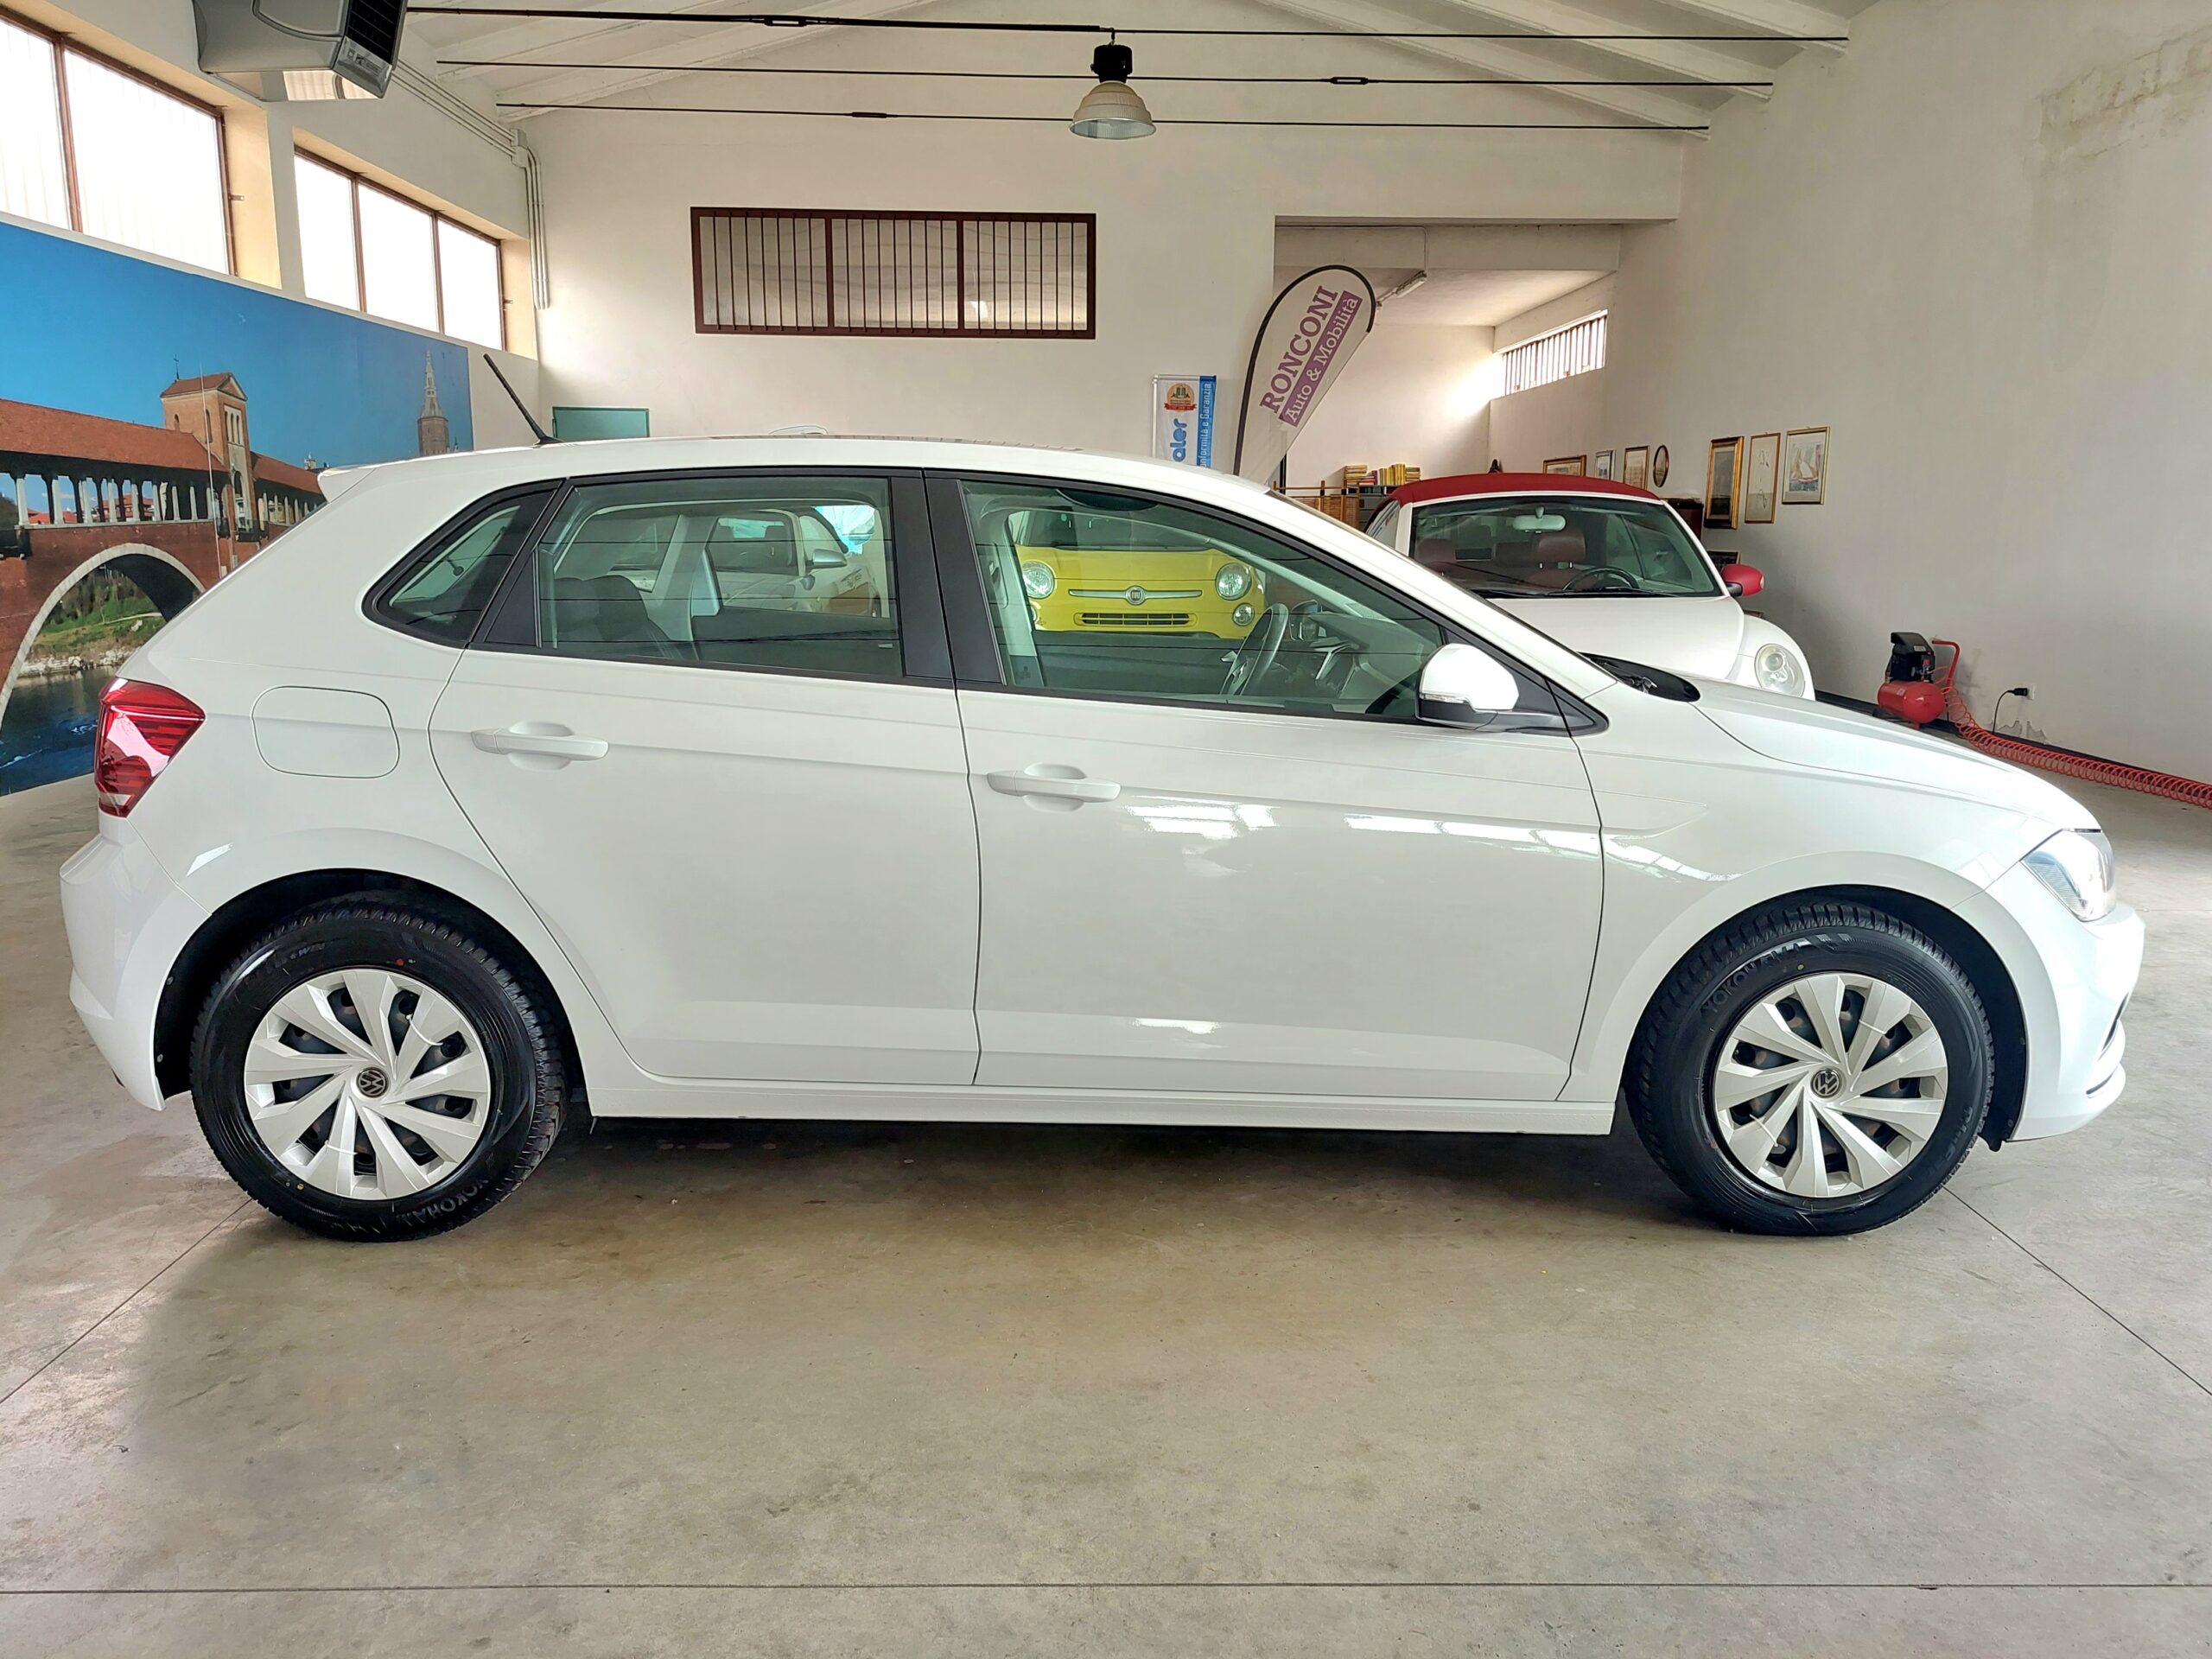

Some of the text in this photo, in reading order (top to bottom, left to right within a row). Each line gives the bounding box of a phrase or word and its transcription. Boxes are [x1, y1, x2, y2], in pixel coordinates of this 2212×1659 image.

[1200, 383, 1211, 419] Garanzia
[1259, 285, 1338, 414] RONCONI
[1286, 298, 1358, 423] Auto & Mobilità
